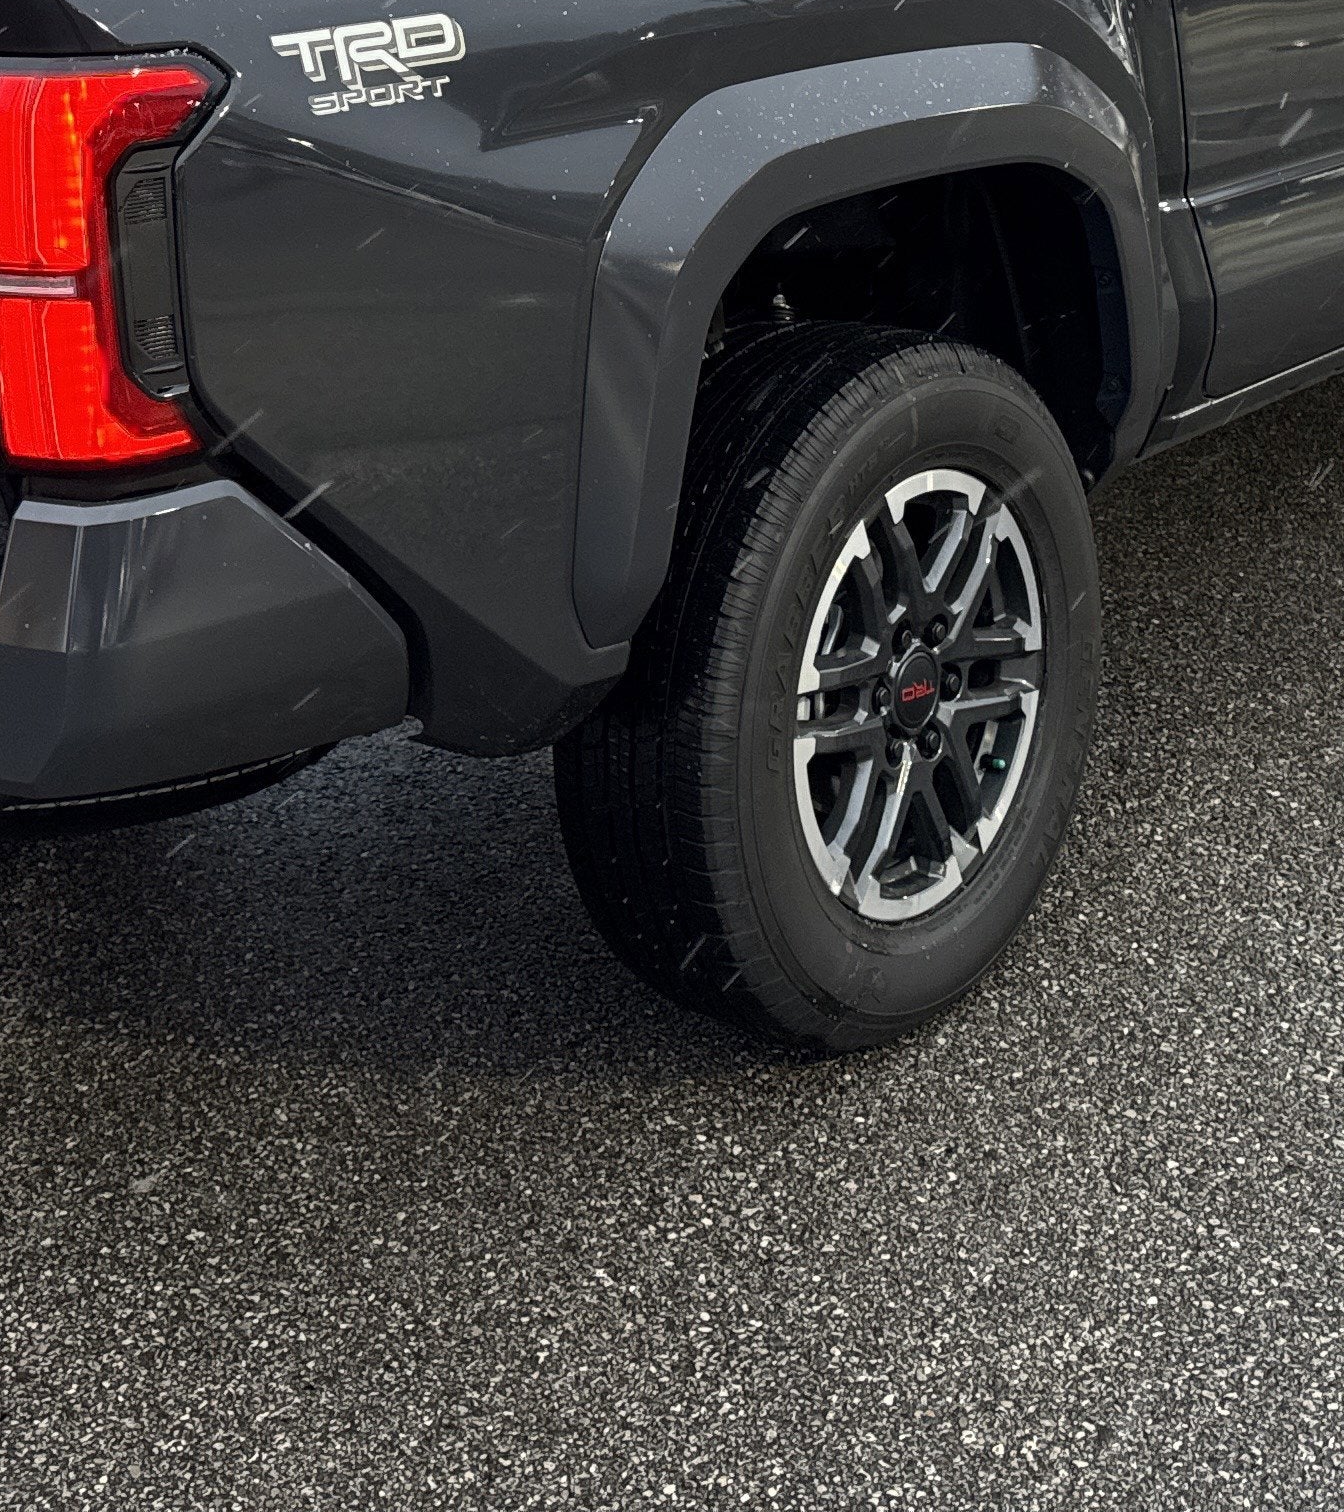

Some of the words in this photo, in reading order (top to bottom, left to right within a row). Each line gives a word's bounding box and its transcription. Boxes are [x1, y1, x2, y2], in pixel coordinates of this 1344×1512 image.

[270, 13, 466, 90] TRD
[309, 76, 451, 116] SPORT
[901, 677, 935, 702] TRD
